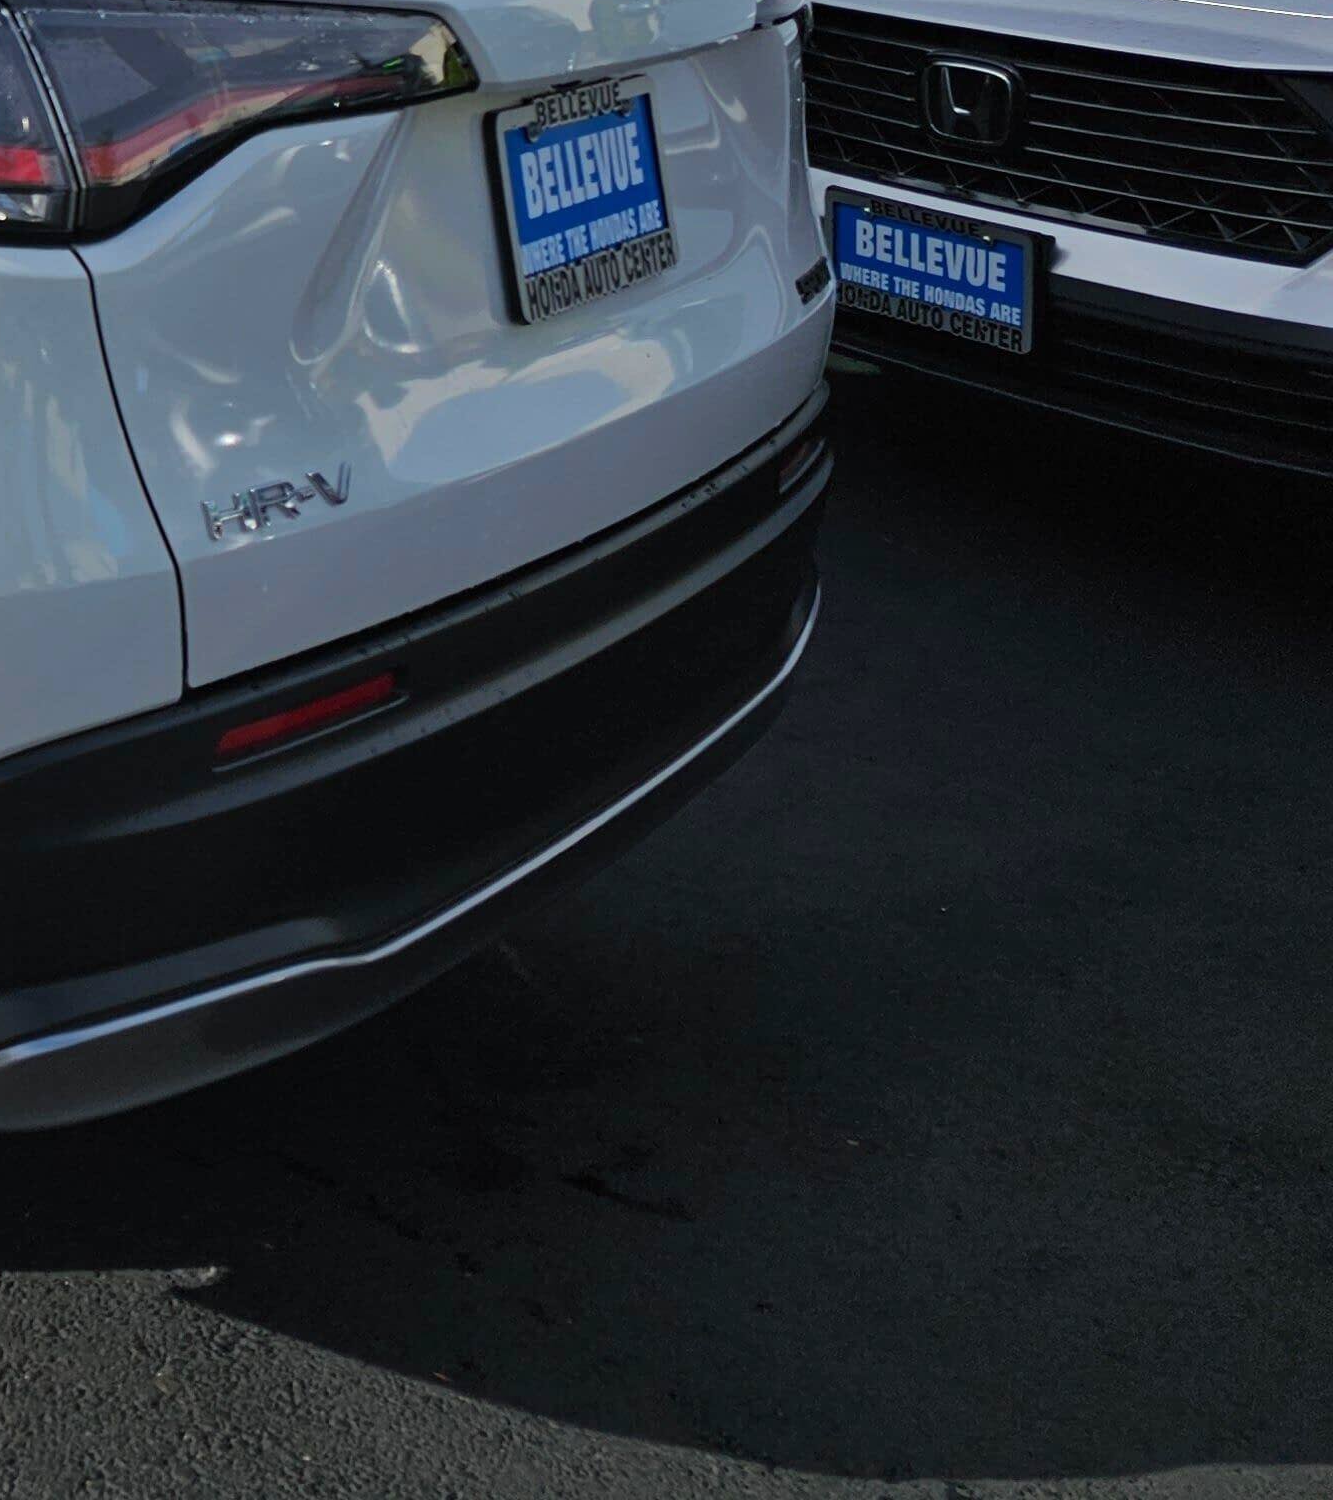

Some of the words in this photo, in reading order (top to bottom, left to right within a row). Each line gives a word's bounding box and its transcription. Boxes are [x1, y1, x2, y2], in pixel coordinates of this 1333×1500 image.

[535, 82, 623, 127] BELLEVUE
[520, 121, 644, 219] BELLEVUE
[520, 232, 565, 275] WHERE
[566, 225, 587, 257] THE
[637, 200, 662, 235] ARE
[855, 218, 1007, 293] BELLEVUE
[870, 199, 982, 239] BELLEVUE
[526, 263, 582, 318] HONDA
[584, 249, 621, 301] AUTO
[622, 231, 677, 283] CENTER
[839, 261, 889, 292] WHERE
[893, 275, 921, 300] THE
[924, 284, 986, 318] HONDAS
[989, 301, 1022, 326] ARE
[896, 299, 944, 331] AUTO
[949, 311, 1024, 352] CENTER
[200, 460, 352, 541] HR-V
